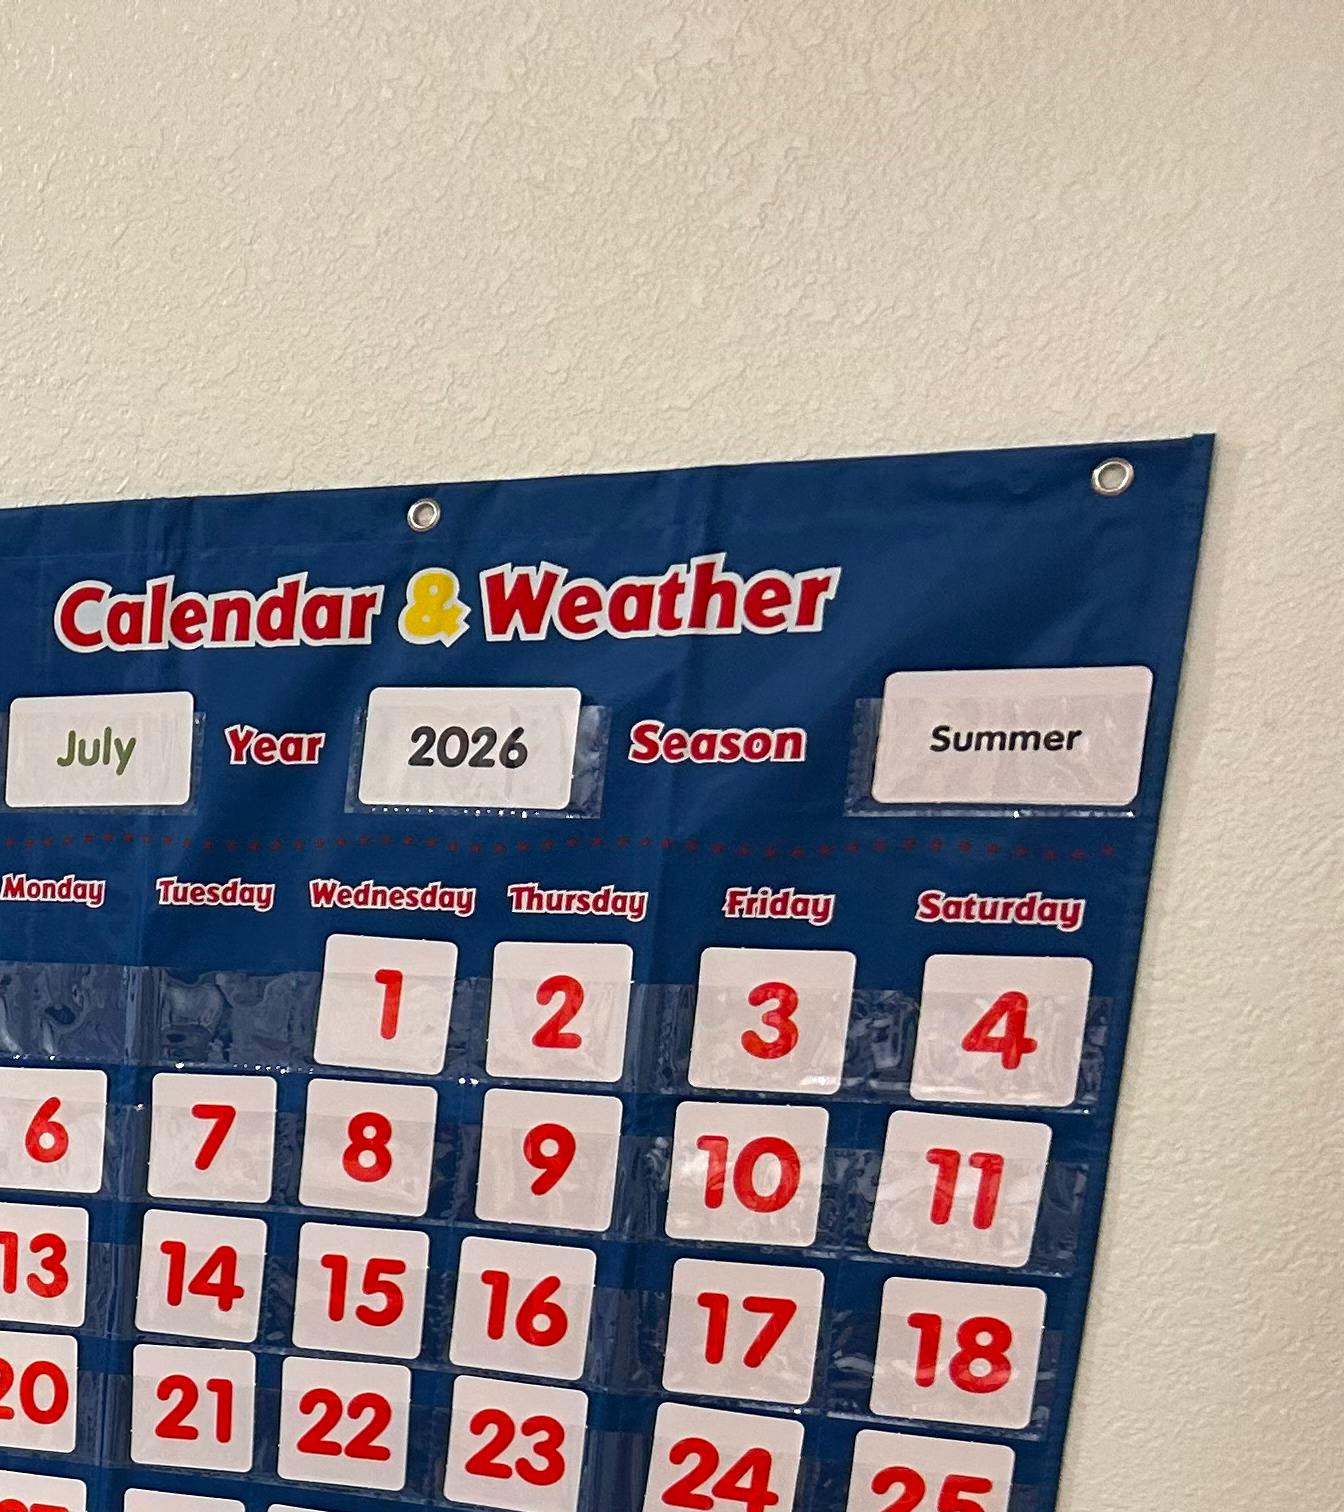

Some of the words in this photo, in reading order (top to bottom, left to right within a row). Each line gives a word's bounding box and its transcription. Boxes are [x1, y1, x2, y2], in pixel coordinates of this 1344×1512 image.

[53, 572, 386, 652] Calendar
[398, 566, 471, 647] &
[480, 551, 841, 643] Weather
[56, 727, 137, 776] July
[225, 724, 326, 766] Year
[407, 725, 528, 769] 2026
[629, 719, 807, 764] Season
[930, 724, 1082, 754] Summer
[0, 874, 106, 907] Monday
[155, 878, 275, 912] Tuesday
[310, 879, 476, 917] Wednesday
[508, 883, 648, 922] Thursday
[723, 887, 835, 925] Friday
[915, 890, 1085, 932] Saturday
[374, 969, 404, 1040] 1
[531, 974, 584, 1050] 2
[740, 981, 799, 1059] 3
[960, 990, 1038, 1070] 4
[25, 1097, 70, 1163] 6
[191, 1103, 236, 1171] 7
[342, 1111, 393, 1182] 8
[523, 1123, 577, 1197] 9
[696, 1135, 801, 1213] 10
[925, 1147, 1004, 1230] 11
[159, 1241, 245, 1312] 14
[320, 1254, 407, 1327] 15
[480, 1269, 568, 1348] 16
[697, 1292, 797, 1369] 17
[906, 1312, 1013, 1394] 18
[154, 1375, 234, 1444] 21
[297, 1388, 392, 1462] 22
[464, 1409, 565, 1487] 23
